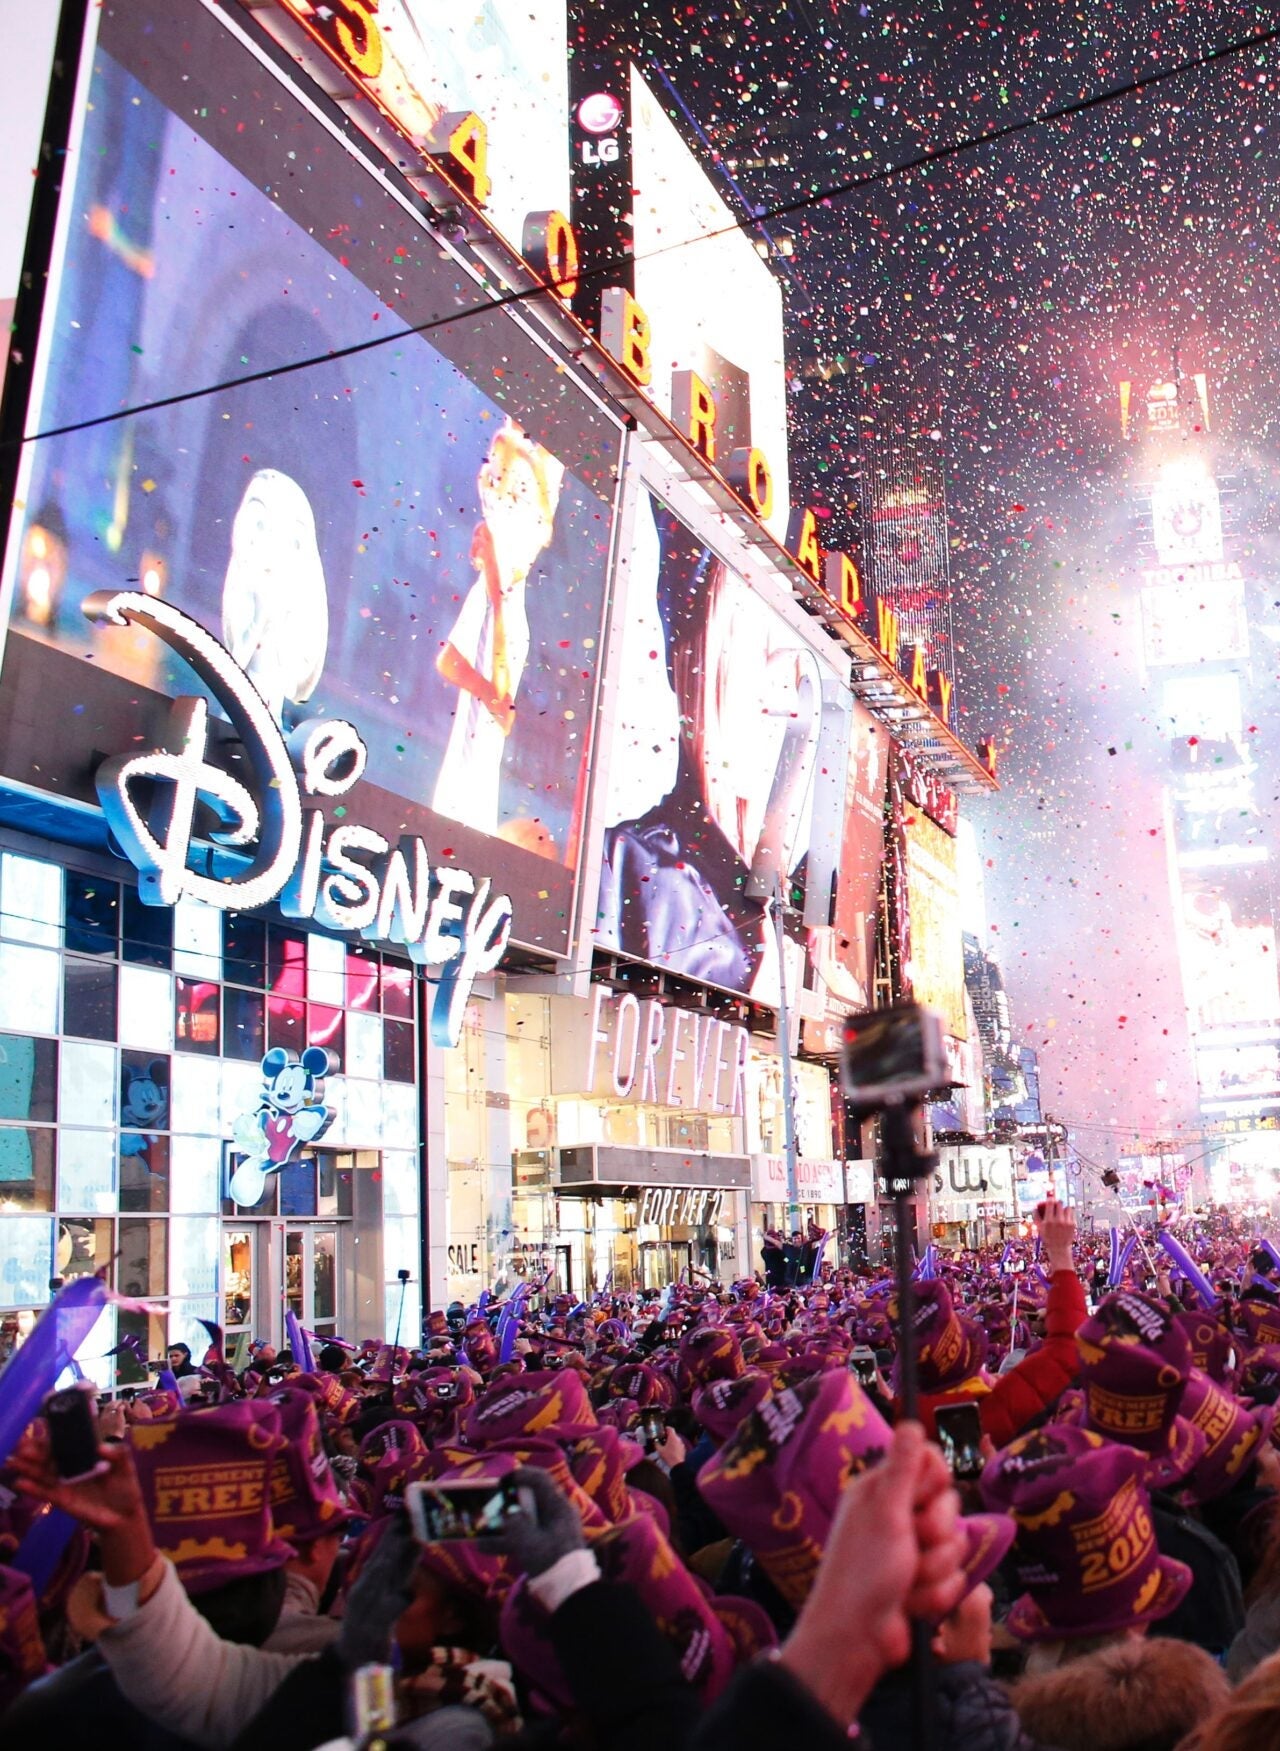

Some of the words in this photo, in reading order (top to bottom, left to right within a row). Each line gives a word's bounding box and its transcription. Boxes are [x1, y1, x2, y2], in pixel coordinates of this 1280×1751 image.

[582, 139, 620, 164] LG
[602, 287, 952, 724] BROADWAY
[586, 984, 750, 1116] FOREVER
[640, 1188, 708, 1226] FOREVER
[709, 1189, 726, 1226] 21
[447, 1243, 479, 1275] SALE
[156, 1470, 264, 1486] JUDGEMENT
[156, 1483, 264, 1515] FREE
[1080, 1505, 1151, 1585] 2016
